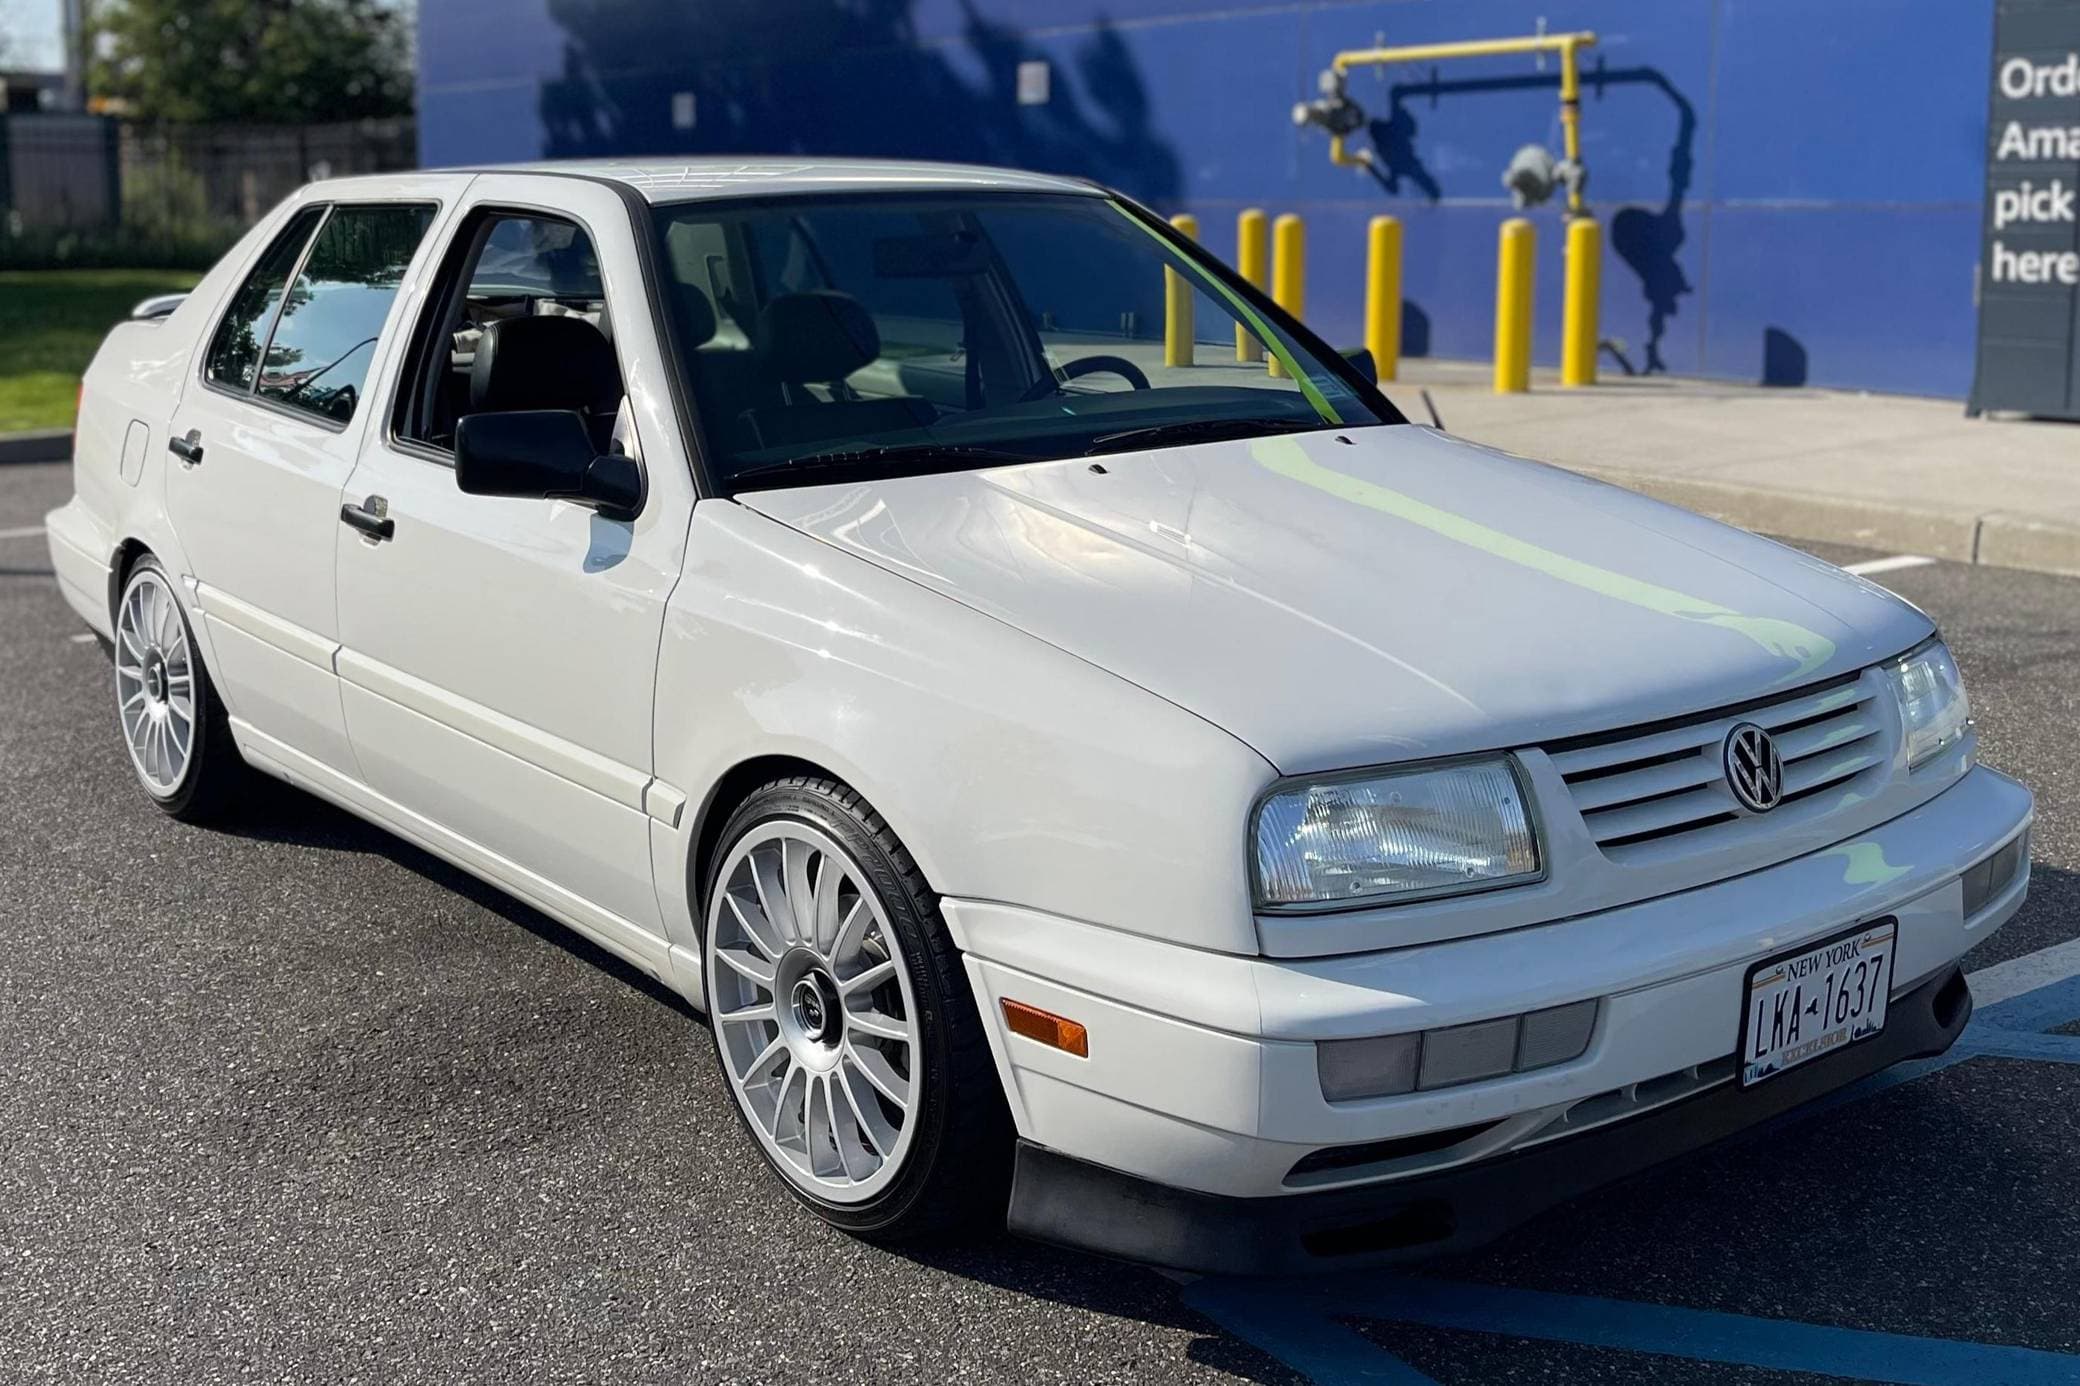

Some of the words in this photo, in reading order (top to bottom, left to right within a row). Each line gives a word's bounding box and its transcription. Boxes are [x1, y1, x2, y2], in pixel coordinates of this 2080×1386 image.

[2001, 53, 2080, 98] Ord
[1994, 180, 2076, 230] pick
[1992, 240, 2079, 284] here
[1787, 953, 1823, 982] NEW
[1826, 939, 1861, 969] YORK
